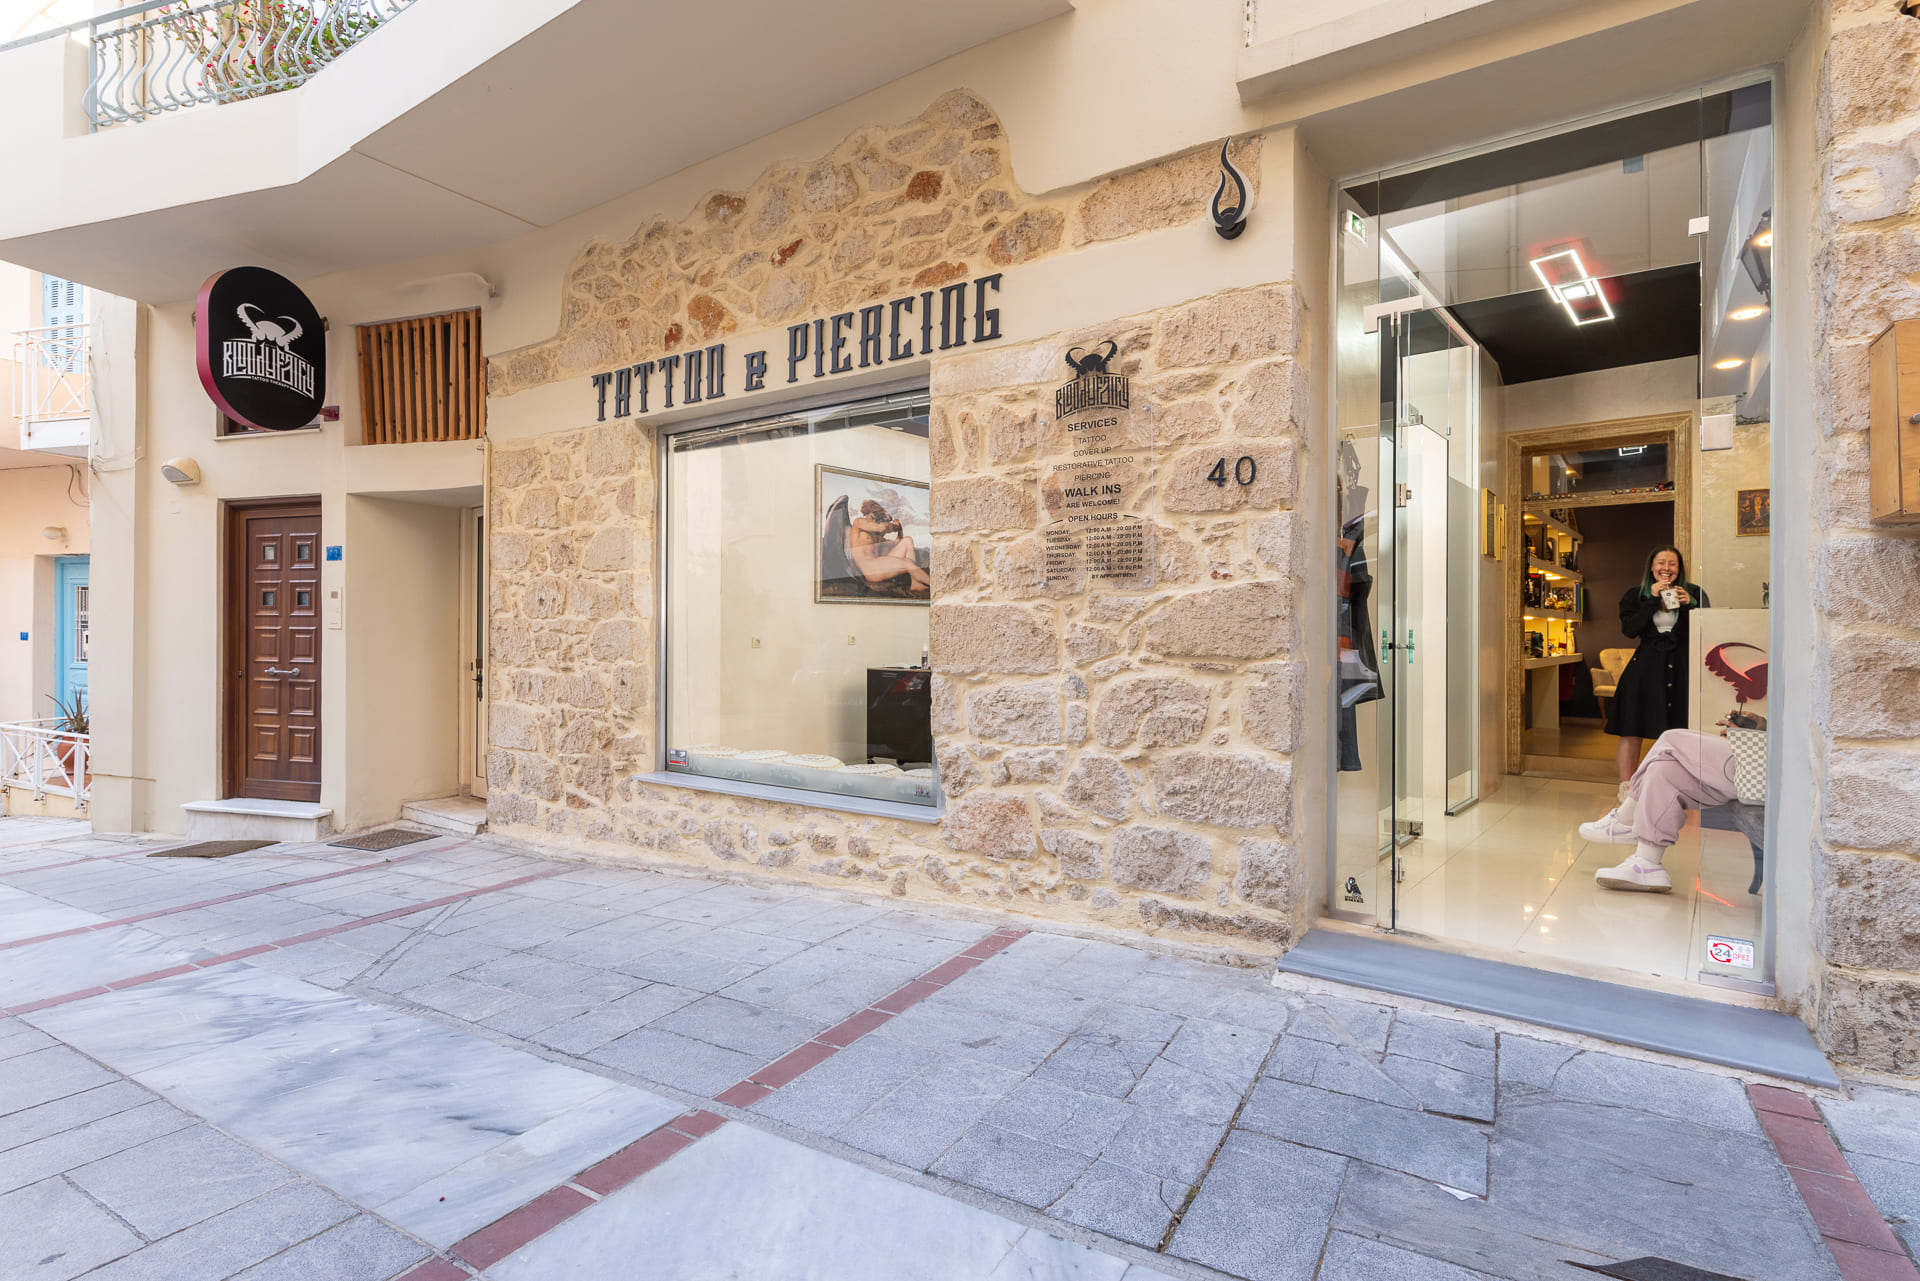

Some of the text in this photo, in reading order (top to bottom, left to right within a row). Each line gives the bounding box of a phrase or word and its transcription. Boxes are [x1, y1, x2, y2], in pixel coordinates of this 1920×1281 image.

[591, 344, 725, 421] TATTOO
[786, 273, 1003, 383] PIERCING
[1067, 417, 1118, 432] SERVICES
[1079, 435, 1107, 444] TATTOO
[1073, 446, 1112, 457] COVER UP
[1053, 456, 1134, 471] RESTORATIVE TATTOO
[1074, 471, 1111, 481] PIERCING
[1207, 456, 1256, 487] 40
[1064, 483, 1122, 498] WALK INS
[1082, 499, 1120, 507] WELCOME!
[1068, 512, 1118, 522] OPEN HOURS
[1714, 948, 1731, 958] 24
